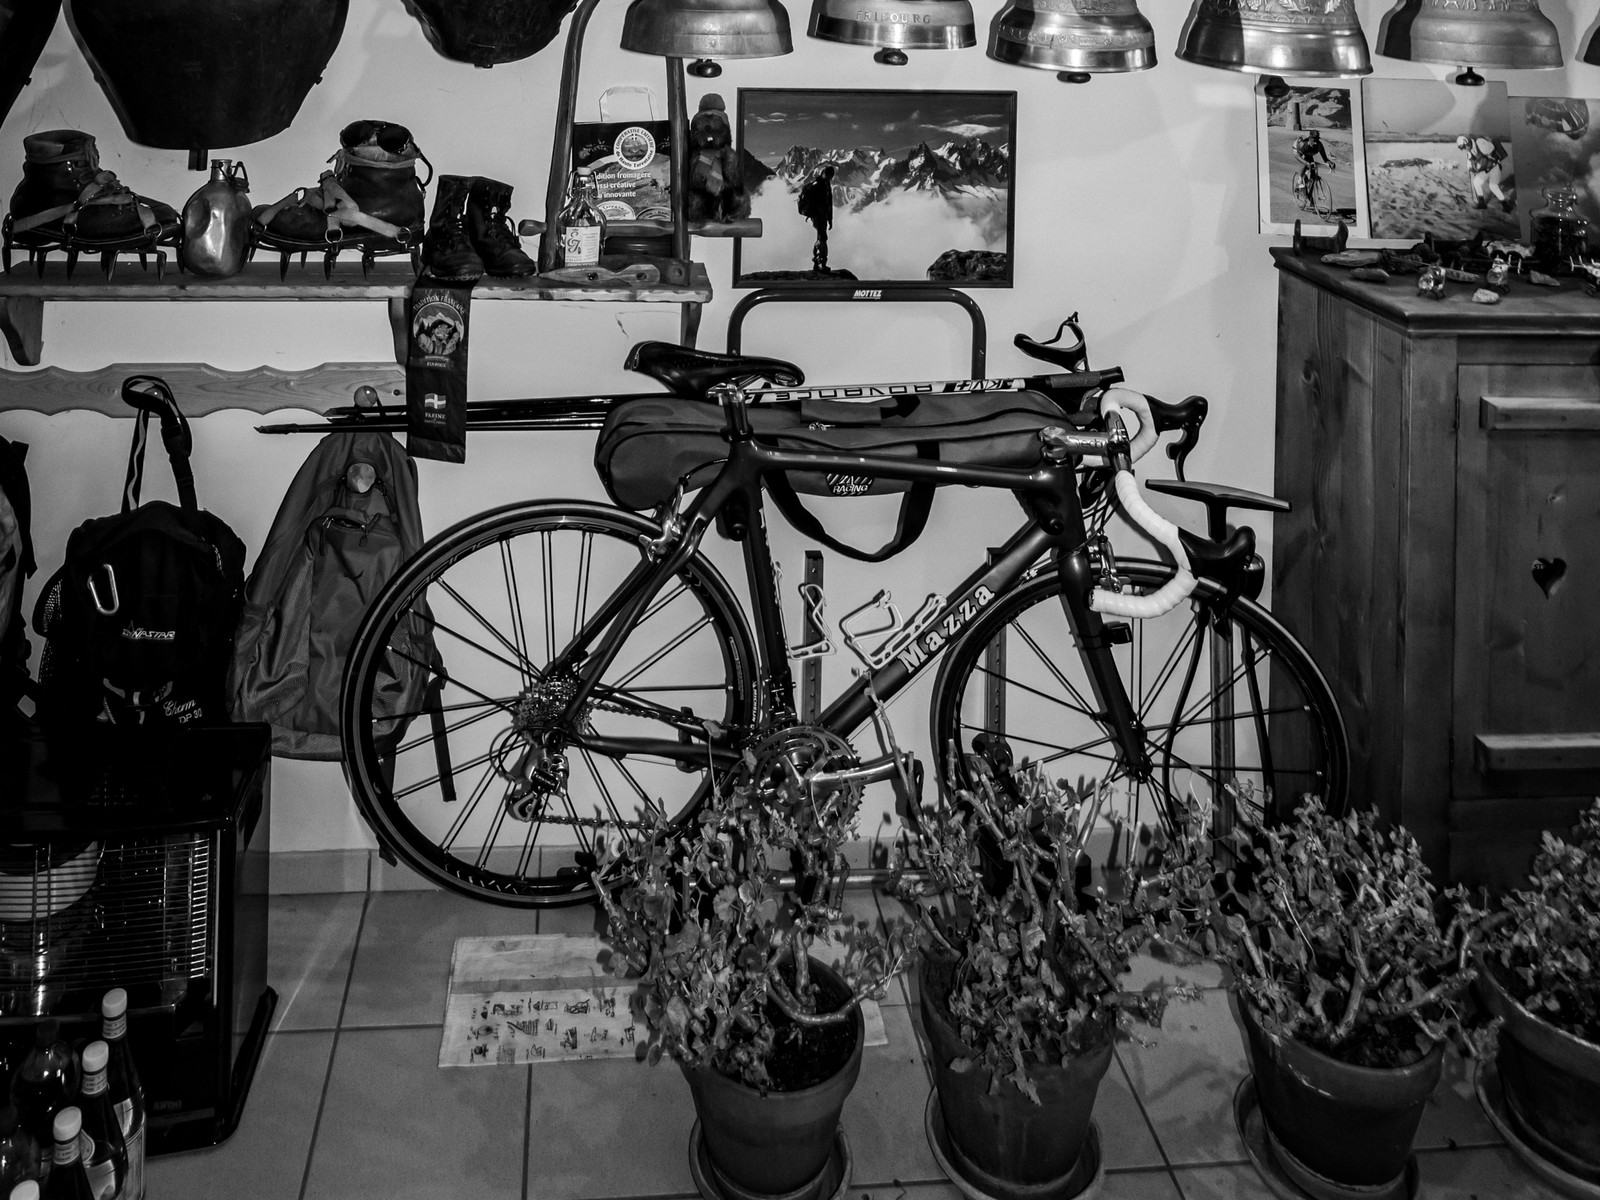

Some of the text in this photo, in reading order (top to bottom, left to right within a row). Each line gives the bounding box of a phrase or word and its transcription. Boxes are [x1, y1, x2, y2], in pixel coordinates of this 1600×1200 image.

[855, 9, 932, 24] FRIBOURG
[596, 172, 616, 180] dition
[853, 289, 883, 297] MOTTEZ
[832, 484, 869, 494] RACING
[896, 583, 996, 675] Mazza
